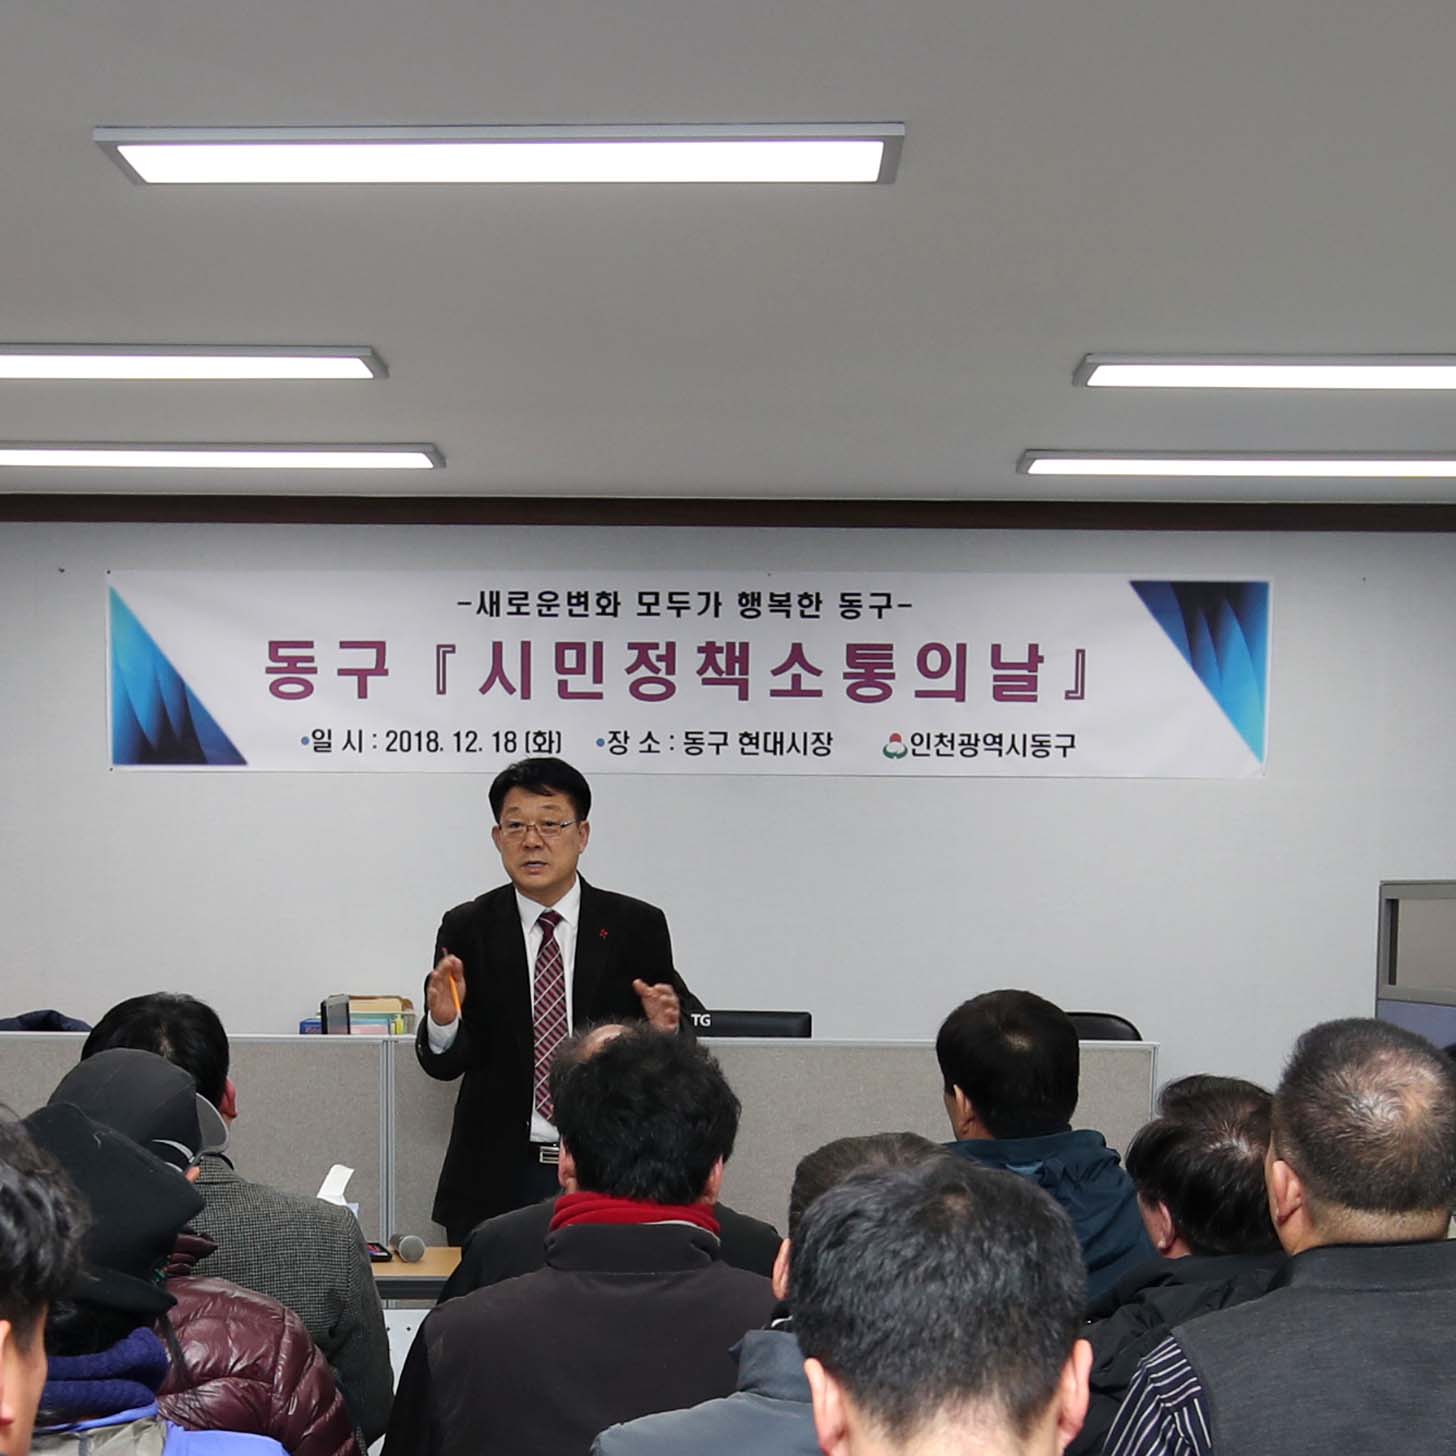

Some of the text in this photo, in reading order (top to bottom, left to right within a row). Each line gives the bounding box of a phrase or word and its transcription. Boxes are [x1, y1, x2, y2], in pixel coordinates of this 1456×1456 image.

[636, 591, 722, 618] 모두가
[737, 591, 823, 619] 행복한
[265, 640, 389, 700] 동구
[683, 731, 728, 756] 동구
[738, 731, 833, 757] 현대시장
[910, 732, 1076, 758] 인천광역시동구
[690, 1013, 711, 1027] TG
